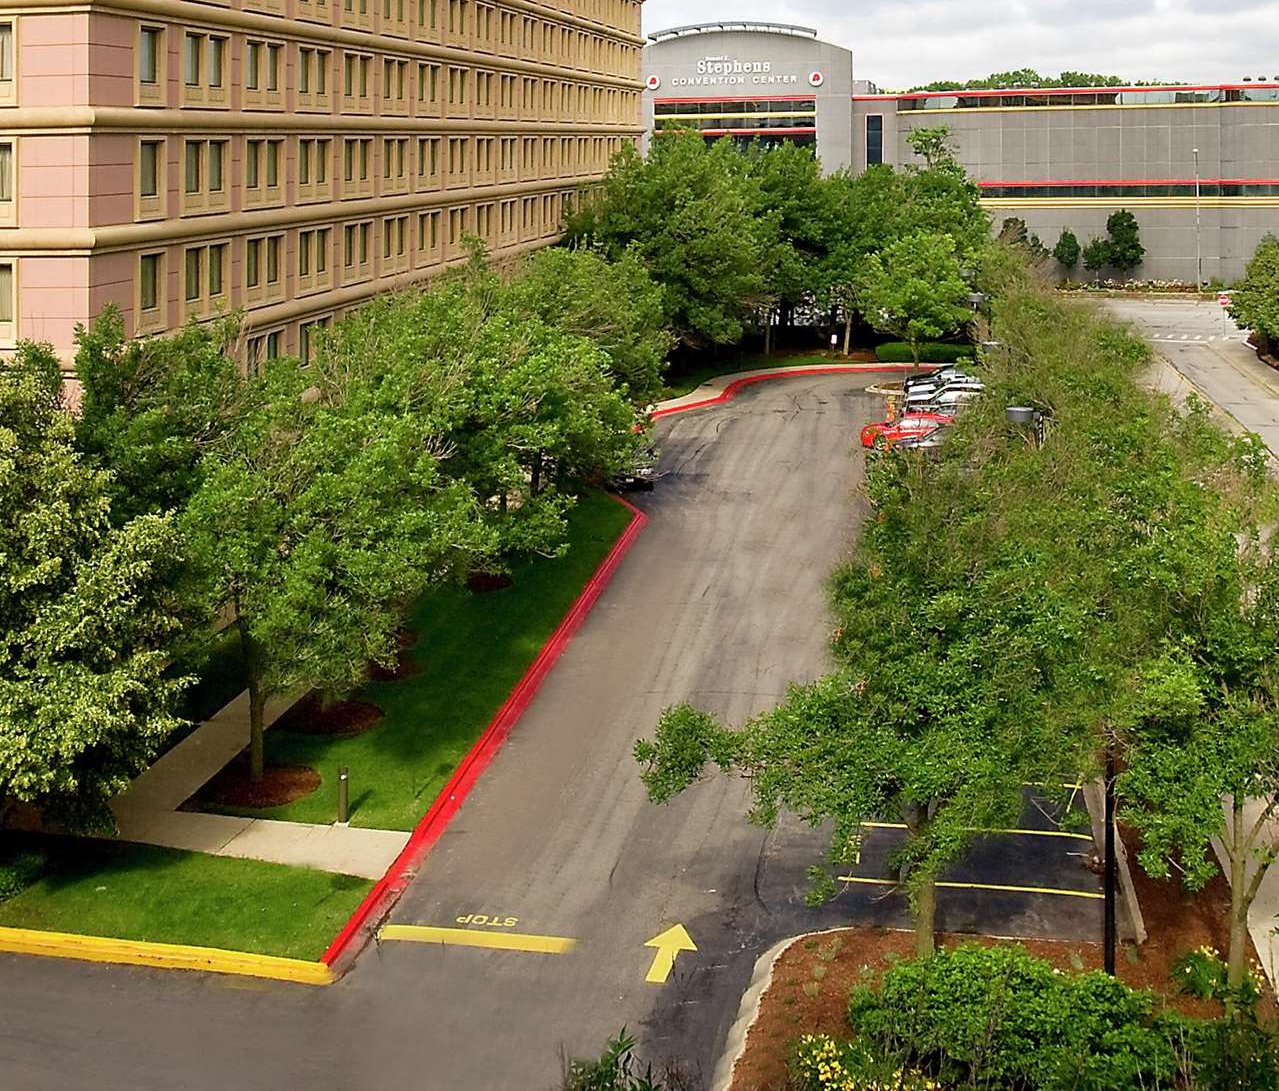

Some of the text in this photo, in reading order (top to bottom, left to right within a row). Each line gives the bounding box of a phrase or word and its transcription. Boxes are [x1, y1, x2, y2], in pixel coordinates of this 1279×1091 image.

[696, 60, 771, 75] Stephens
[672, 75, 798, 86] CONVENTION CENTER
[455, 913, 519, 927] STOP
